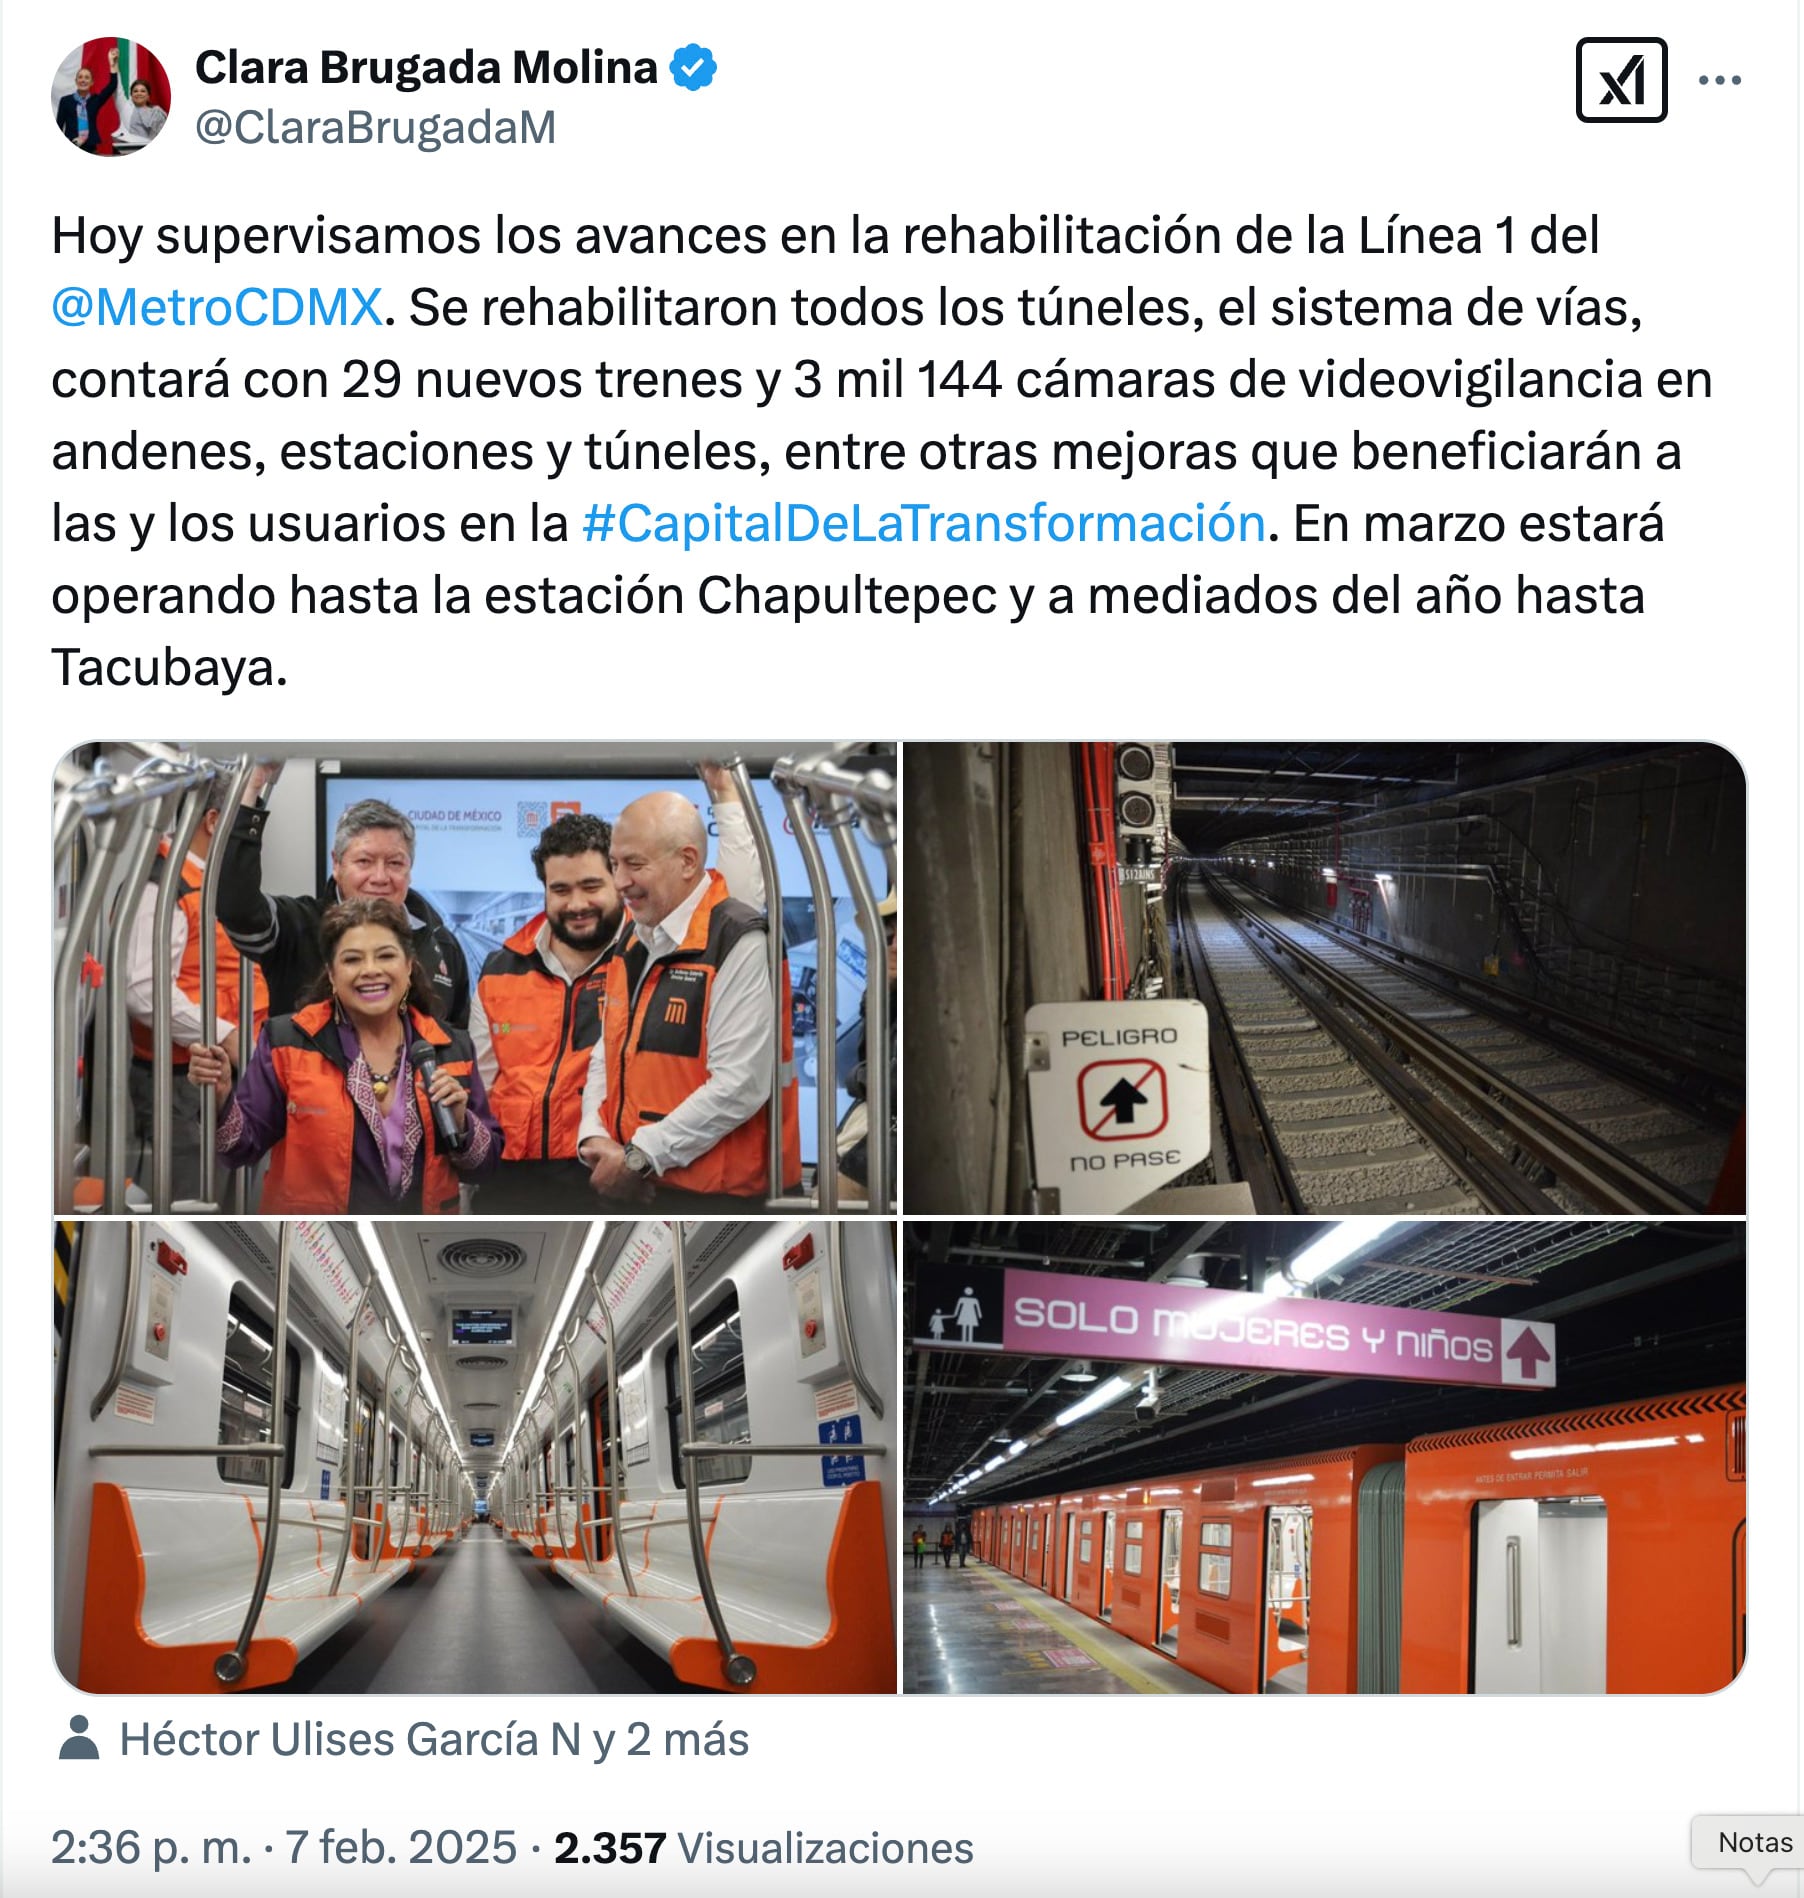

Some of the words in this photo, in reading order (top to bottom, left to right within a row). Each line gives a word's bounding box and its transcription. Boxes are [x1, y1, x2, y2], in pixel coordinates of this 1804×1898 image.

[196, 48, 308, 84] Clara
[322, 48, 500, 92] Brugada
[514, 48, 657, 84] Molina
[197, 108, 554, 152] @ClaraBrugadaM
[54, 216, 143, 264] Hoy
[157, 214, 480, 263] supervisamos
[497, 214, 560, 254] los
[576, 225, 766, 254] avances
[782, 225, 835, 254] en
[853, 214, 888, 254] la
[906, 213, 1220, 254] rehabilitación
[1237, 214, 1292, 254] de
[1309, 214, 1344, 254] la
[1361, 214, 1481, 254] Línea
[1497, 216, 1512, 253] 1
[1531, 214, 1597, 254] del
[53, 287, 394, 327] @MetroCDMX.
[410, 287, 467, 326] Se
[484, 286, 776, 326] rehabilitaron
[791, 286, 923, 326] todos
[940, 286, 1003, 326] los
[1018, 286, 1203, 333] túneles,
[1219, 286, 1255, 326] el
[1272, 286, 1452, 326] sistema
[1468, 286, 1523, 326] de
[1536, 285, 1640, 333] vías,
[53, 358, 229, 398] contará
[245, 369, 327, 398] con
[344, 359, 400, 398] 29
[418, 369, 581, 398] nuevos
[595, 361, 742, 398] trenes
[756, 369, 781, 408] y
[795, 359, 821, 398] 3
[839, 358, 902, 397] mil
[919, 360, 1002, 397] 144
[1017, 358, 1214, 398] cámaras
[1230, 358, 1285, 398] de
[1299, 358, 1642, 408] videovigilancia
[1658, 369, 1711, 398] en
[53, 430, 264, 477] andenes,
[281, 430, 533, 470] estaciones
[546, 441, 572, 480] y
[584, 430, 769, 477] túneles,
[786, 433, 905, 470] entre
[920, 433, 1037, 470] otras
[1054, 430, 1236, 480] mejoras
[1252, 441, 1337, 479] que
[1354, 429, 1640, 470] beneficiarán
[1657, 441, 1680, 470] a
[54, 502, 115, 542] las
[129, 513, 155, 552] y
[170, 502, 233, 542] los
[250, 502, 445, 542] usuarios
[461, 513, 514, 542] en
[532, 502, 567, 542] la
[583, 501, 1278, 551] #CapitalDeLaTransformación.
[1296, 504, 1347, 541] En
[1366, 513, 1505, 542] marzo
[1520, 501, 1663, 542] estará
[53, 574, 275, 623] operando
[292, 574, 418, 614] hasta
[435, 574, 470, 614] la
[486, 573, 682, 614] estación
[699, 574, 996, 623] Chapultepec
[1009, 585, 1035, 624] y
[1049, 585, 1073, 614] a
[1090, 574, 1317, 614] mediados
[1333, 574, 1399, 614] del
[1417, 574, 1501, 614] año
[1518, 574, 1644, 614] hasta
[51, 646, 286, 696] Tacubaya.
[408, 810, 445, 821] CIUDAD
[448, 810, 461, 821] DE
[463, 808, 502, 821] MÉXICO
[1062, 1028, 1178, 1047] PELIGRO
[1114, 1150, 1181, 1168] PASE
[1015, 1297, 1139, 1334] SOLO
[1362, 1327, 1385, 1353] Y
[1507, 1472, 1532, 1481] ENTRAR
[1567, 1467, 1589, 1478] SALIR
[122, 1720, 260, 1756] Héctor
[273, 1720, 394, 1756] Ulises
[408, 1720, 537, 1756] García
[553, 1722, 579, 1755] N
[593, 1731, 616, 1764] y
[628, 1722, 650, 1755] 2
[666, 1720, 748, 1756] más
[52, 1830, 140, 1864] 2:36
[155, 1838, 188, 1872] p.
[204, 1838, 250, 1864] m.
[286, 1830, 308, 1863] 7
[319, 1828, 395, 1864] feb.
[410, 1830, 516, 1864] 2025
[555, 1832, 666, 1864] 2.357
[677, 1831, 973, 1864] Visualizaciones
[1720, 1832, 1793, 1853] Notas
